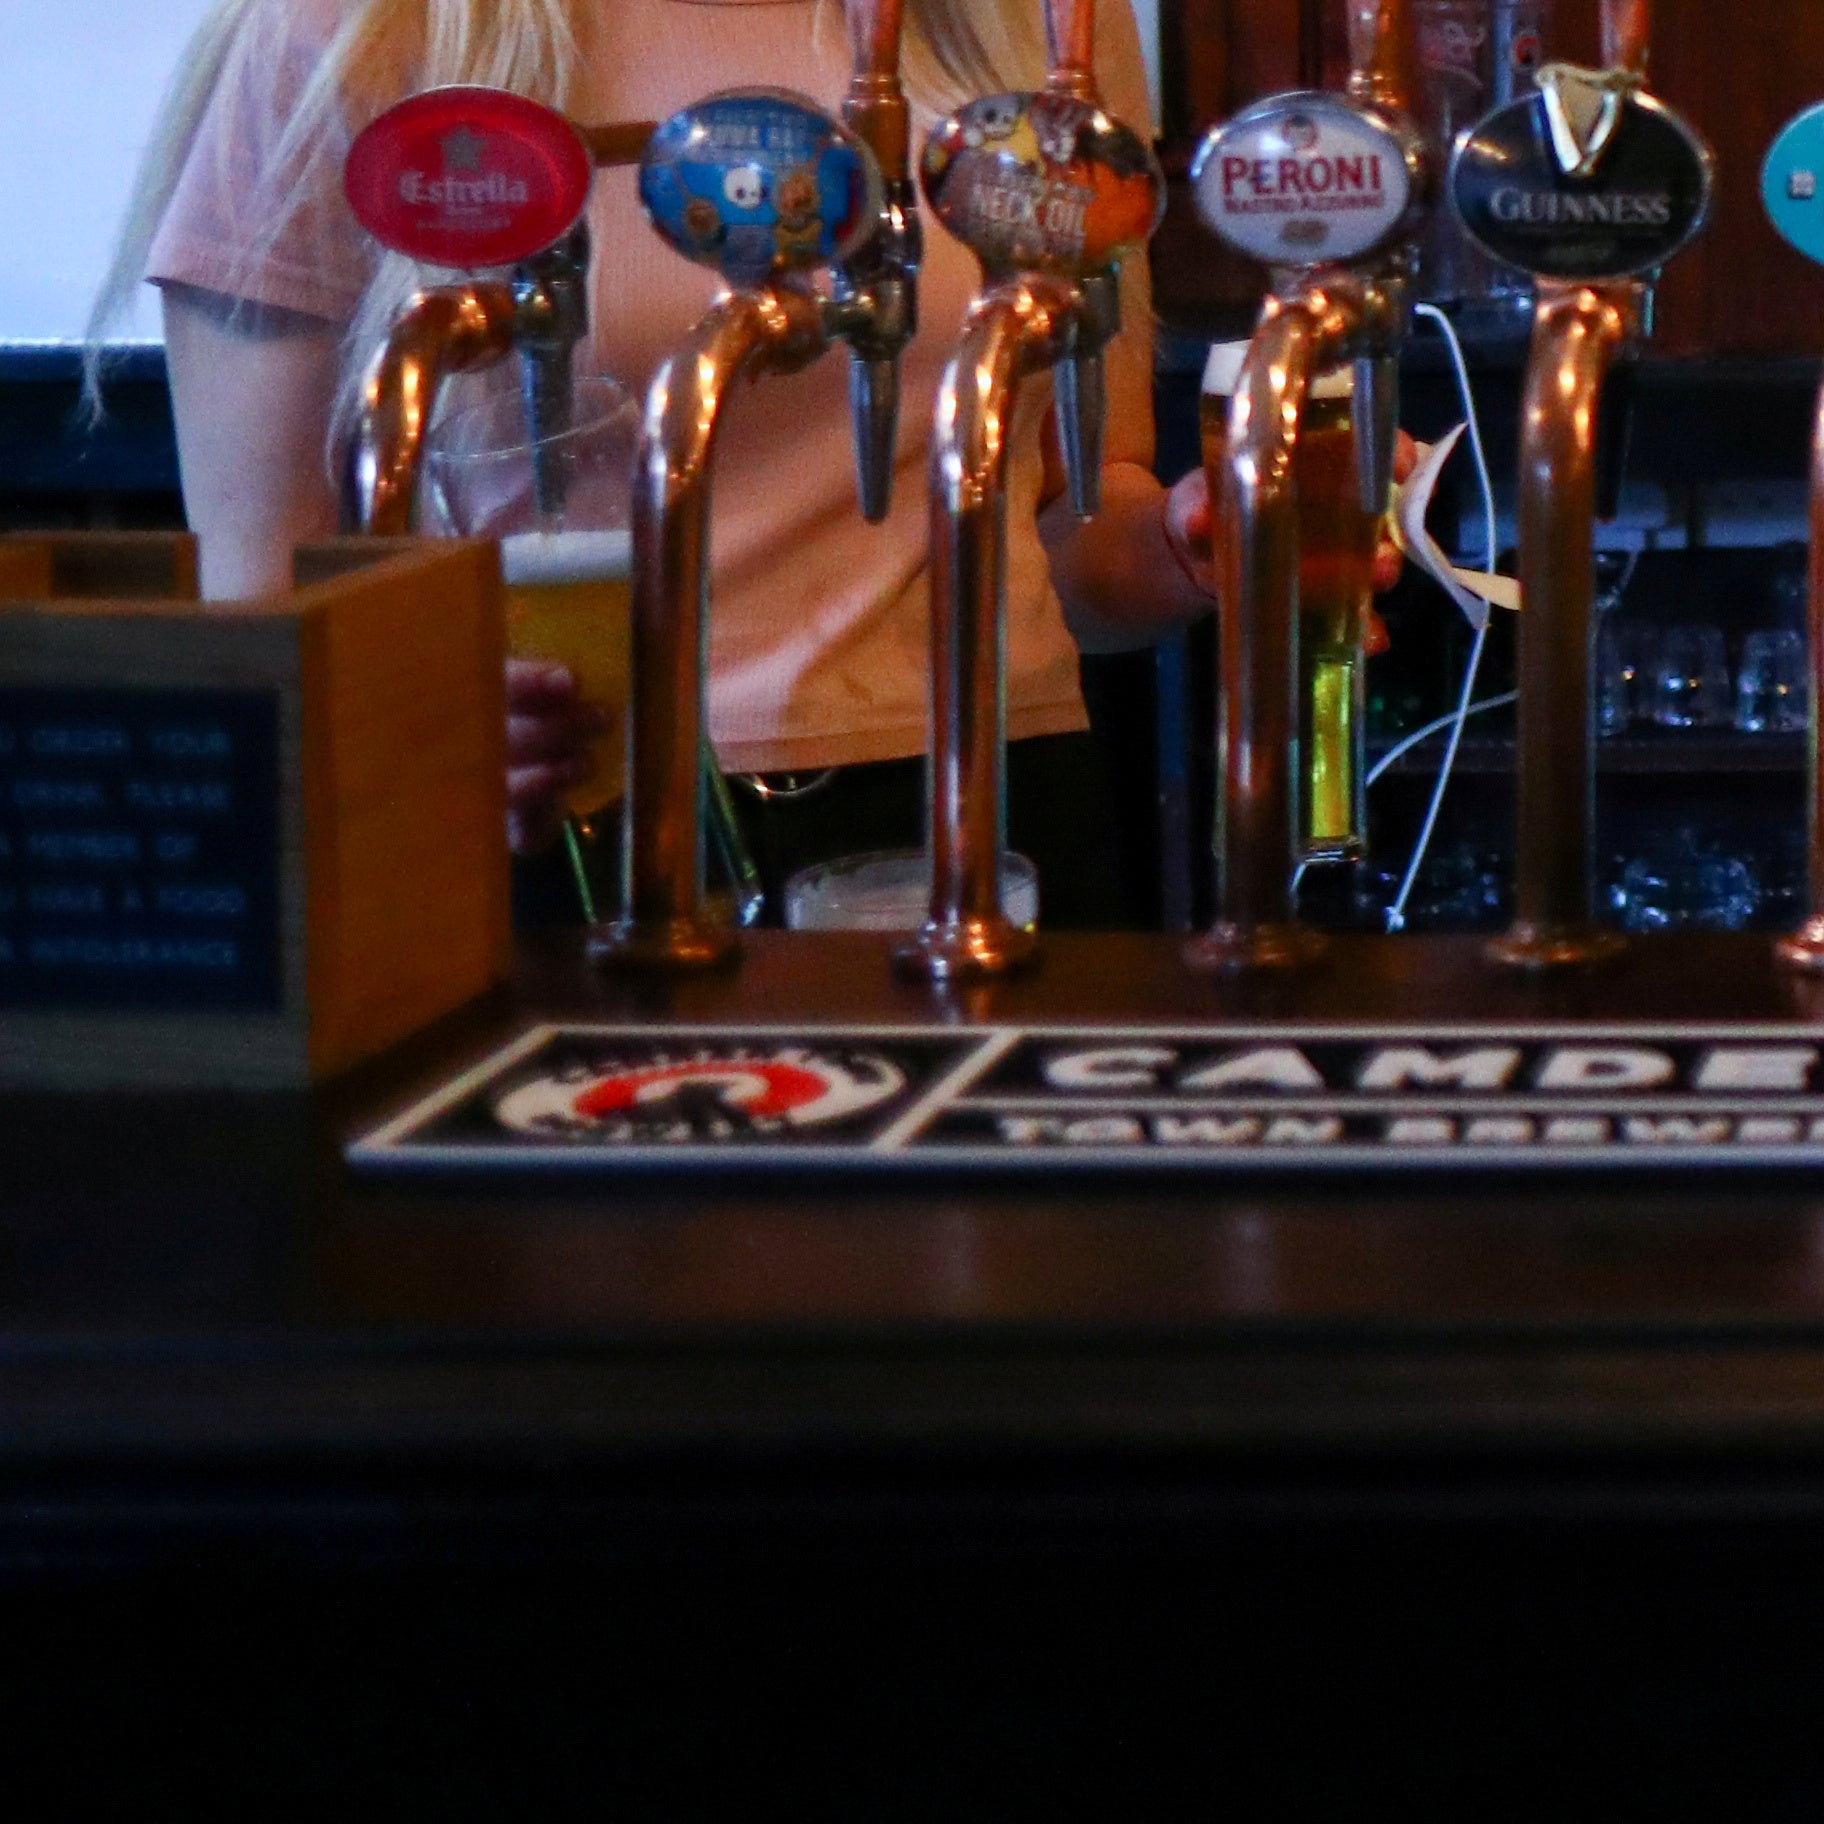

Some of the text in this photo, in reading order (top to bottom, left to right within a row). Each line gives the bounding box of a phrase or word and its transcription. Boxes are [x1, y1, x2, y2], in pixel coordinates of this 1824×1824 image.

[396, 170, 529, 205] Estrella
[1220, 154, 1383, 197] PERONI
[1489, 185, 1672, 226] GUINNESS
[999, 1116, 1346, 1144] TOWN
